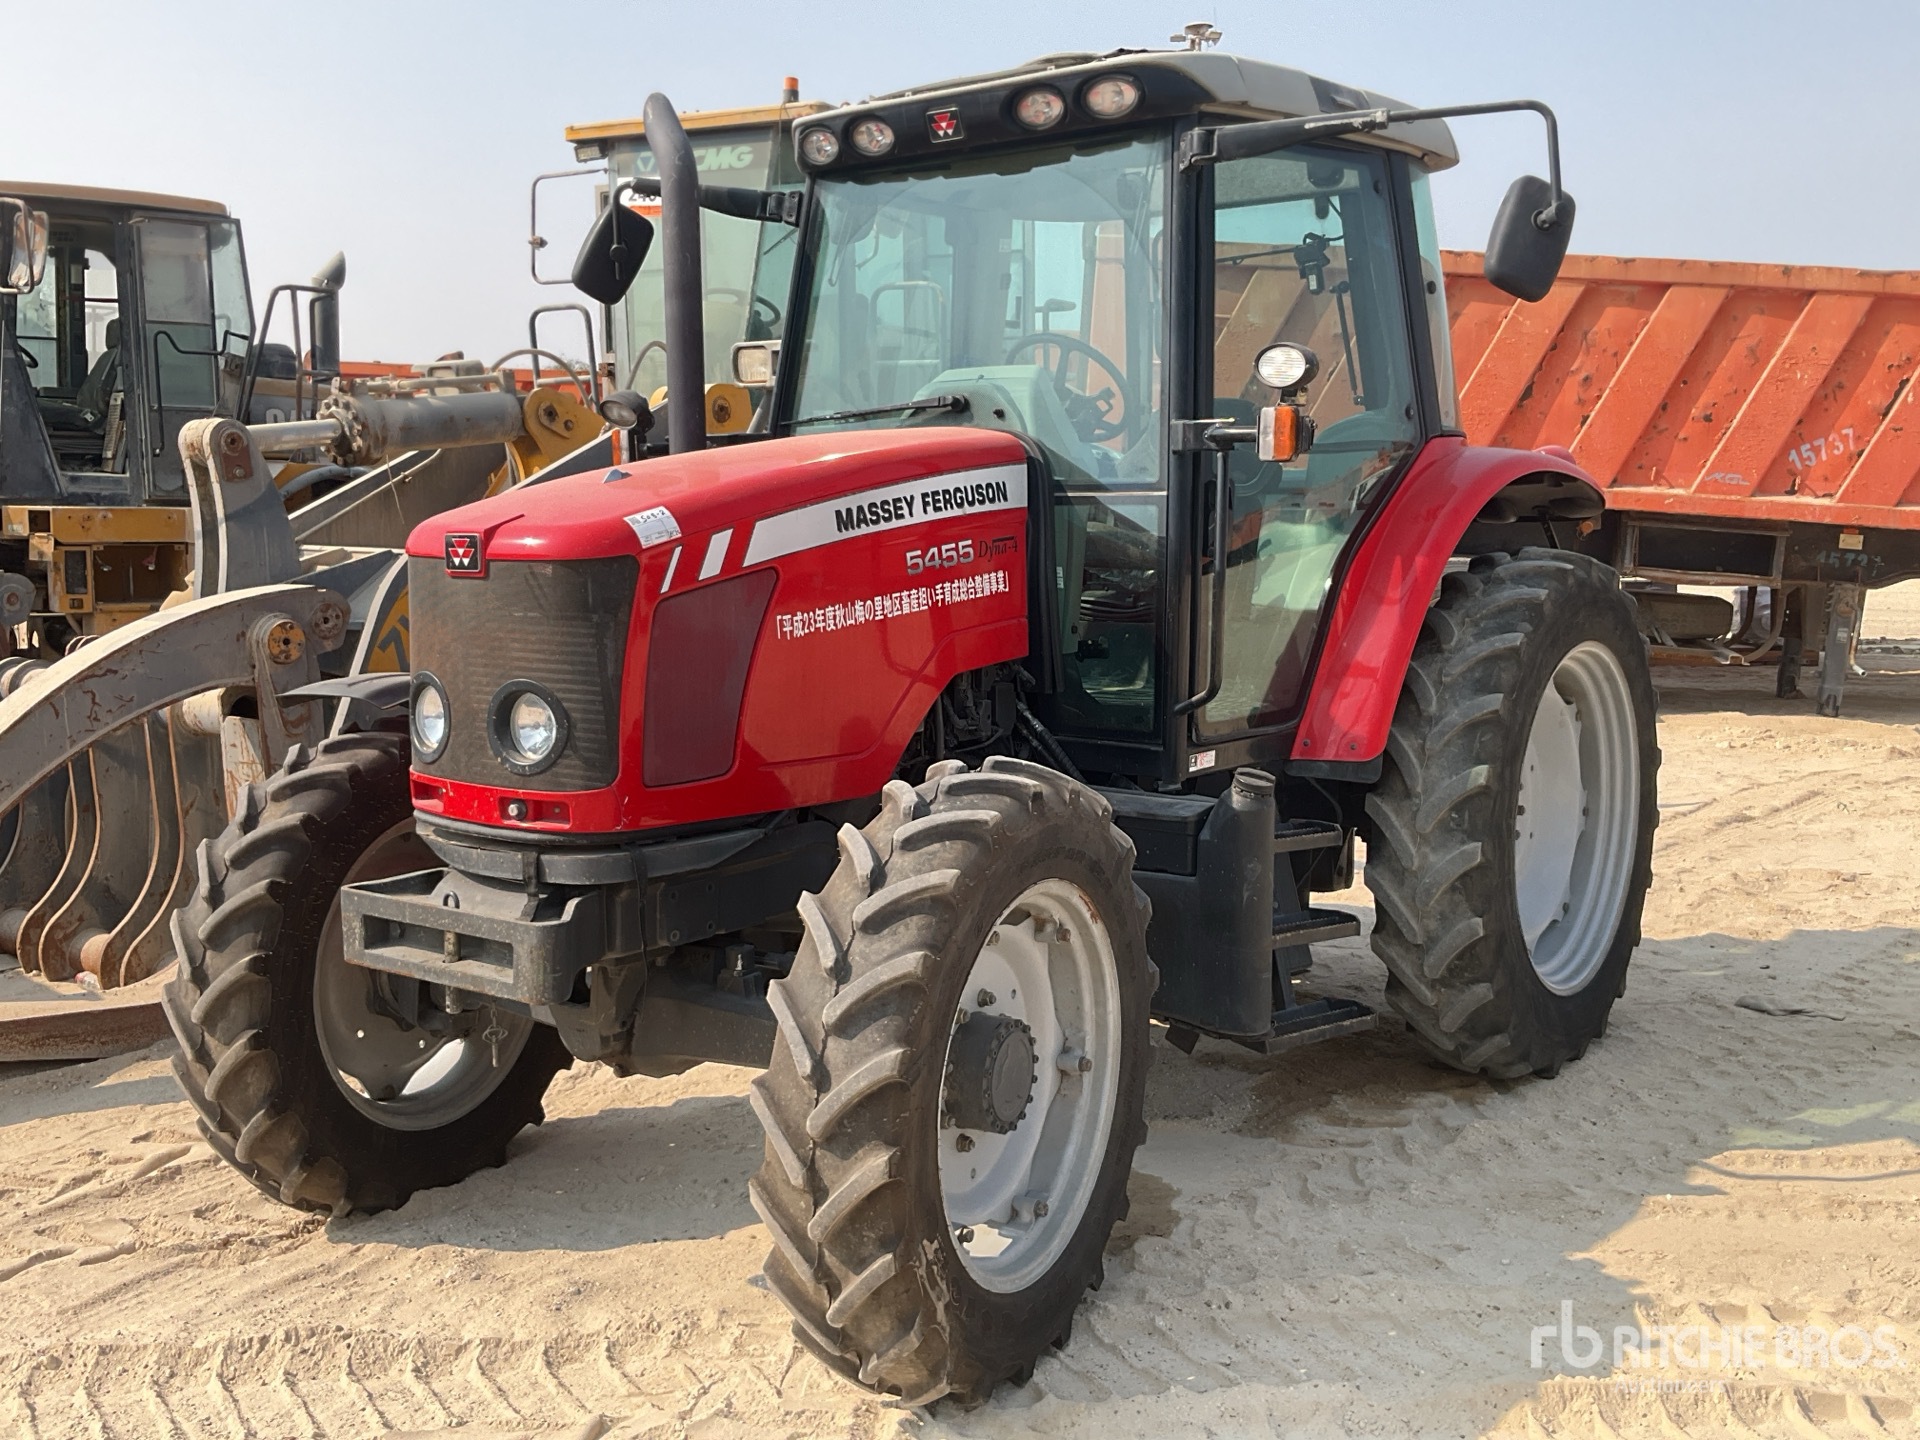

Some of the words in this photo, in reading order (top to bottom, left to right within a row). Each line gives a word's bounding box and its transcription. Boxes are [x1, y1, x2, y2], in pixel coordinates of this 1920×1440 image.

[693, 146, 754, 170] CMG
[1789, 428, 1855, 470] 15737
[834, 494, 915, 533] MASSEY
[920, 481, 1008, 515] FERGUSON
[905, 539, 975, 576] 5455
[978, 536, 1018, 562] Dyna-4
